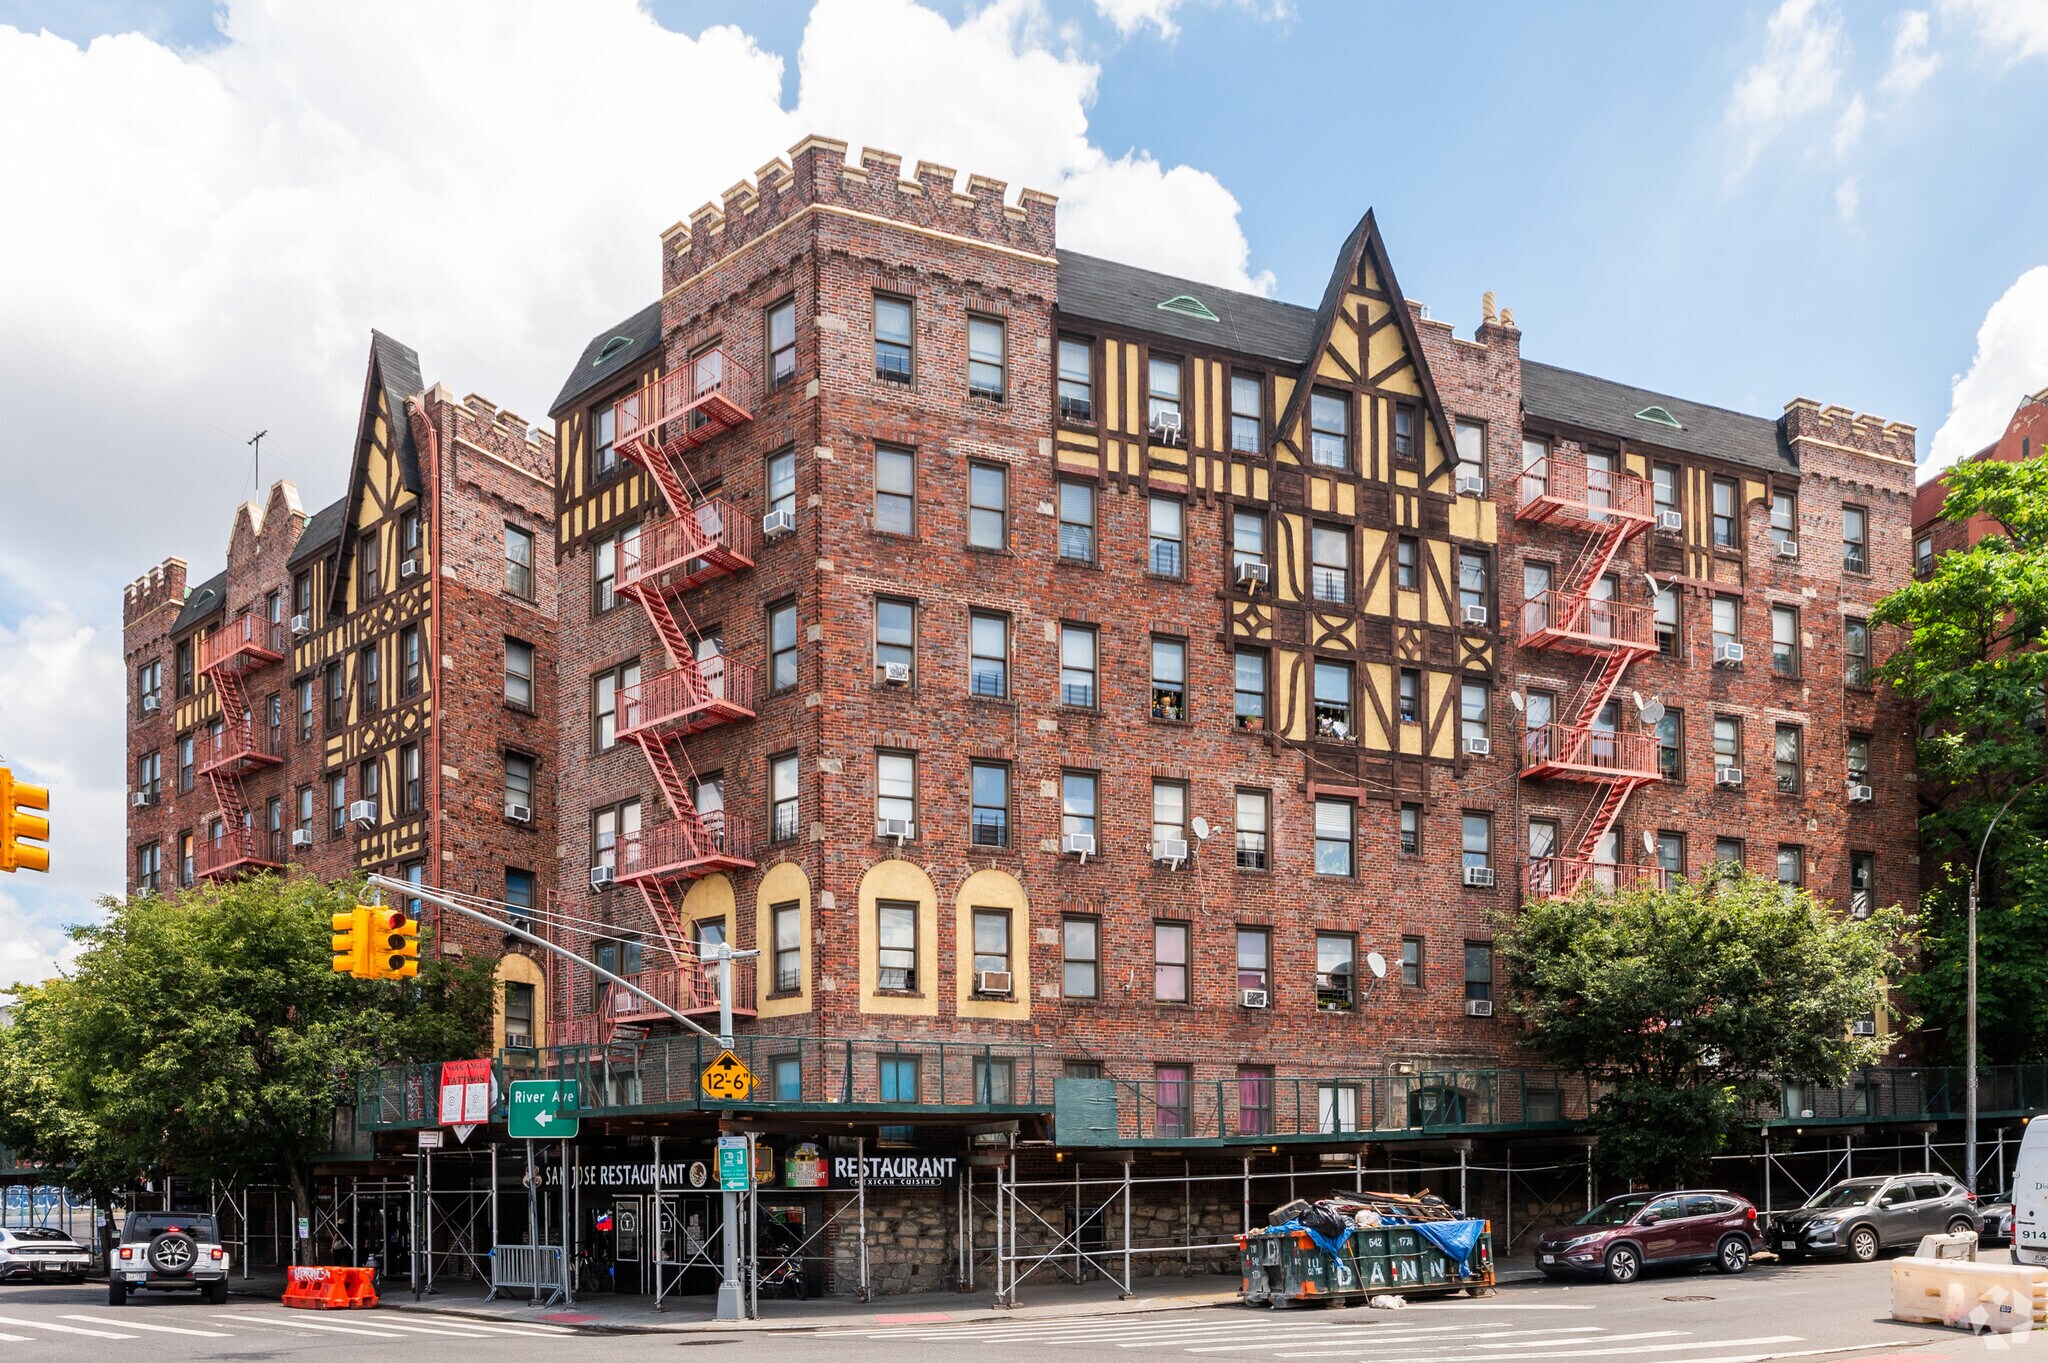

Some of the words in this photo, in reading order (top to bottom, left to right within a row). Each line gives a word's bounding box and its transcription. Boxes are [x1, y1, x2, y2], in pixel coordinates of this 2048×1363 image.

[466, 1061, 488, 1069] ANGEL
[447, 1075, 485, 1085] TATTOOS
[707, 1073, 749, 1090] 12'-6"
[515, 1090, 545, 1103] River
[834, 1157, 957, 1178] RESTAURANT
[600, 1164, 686, 1185] RESTAURANT
[2022, 1230, 2047, 1240] 914
[1368, 1237, 1383, 1248] 542
